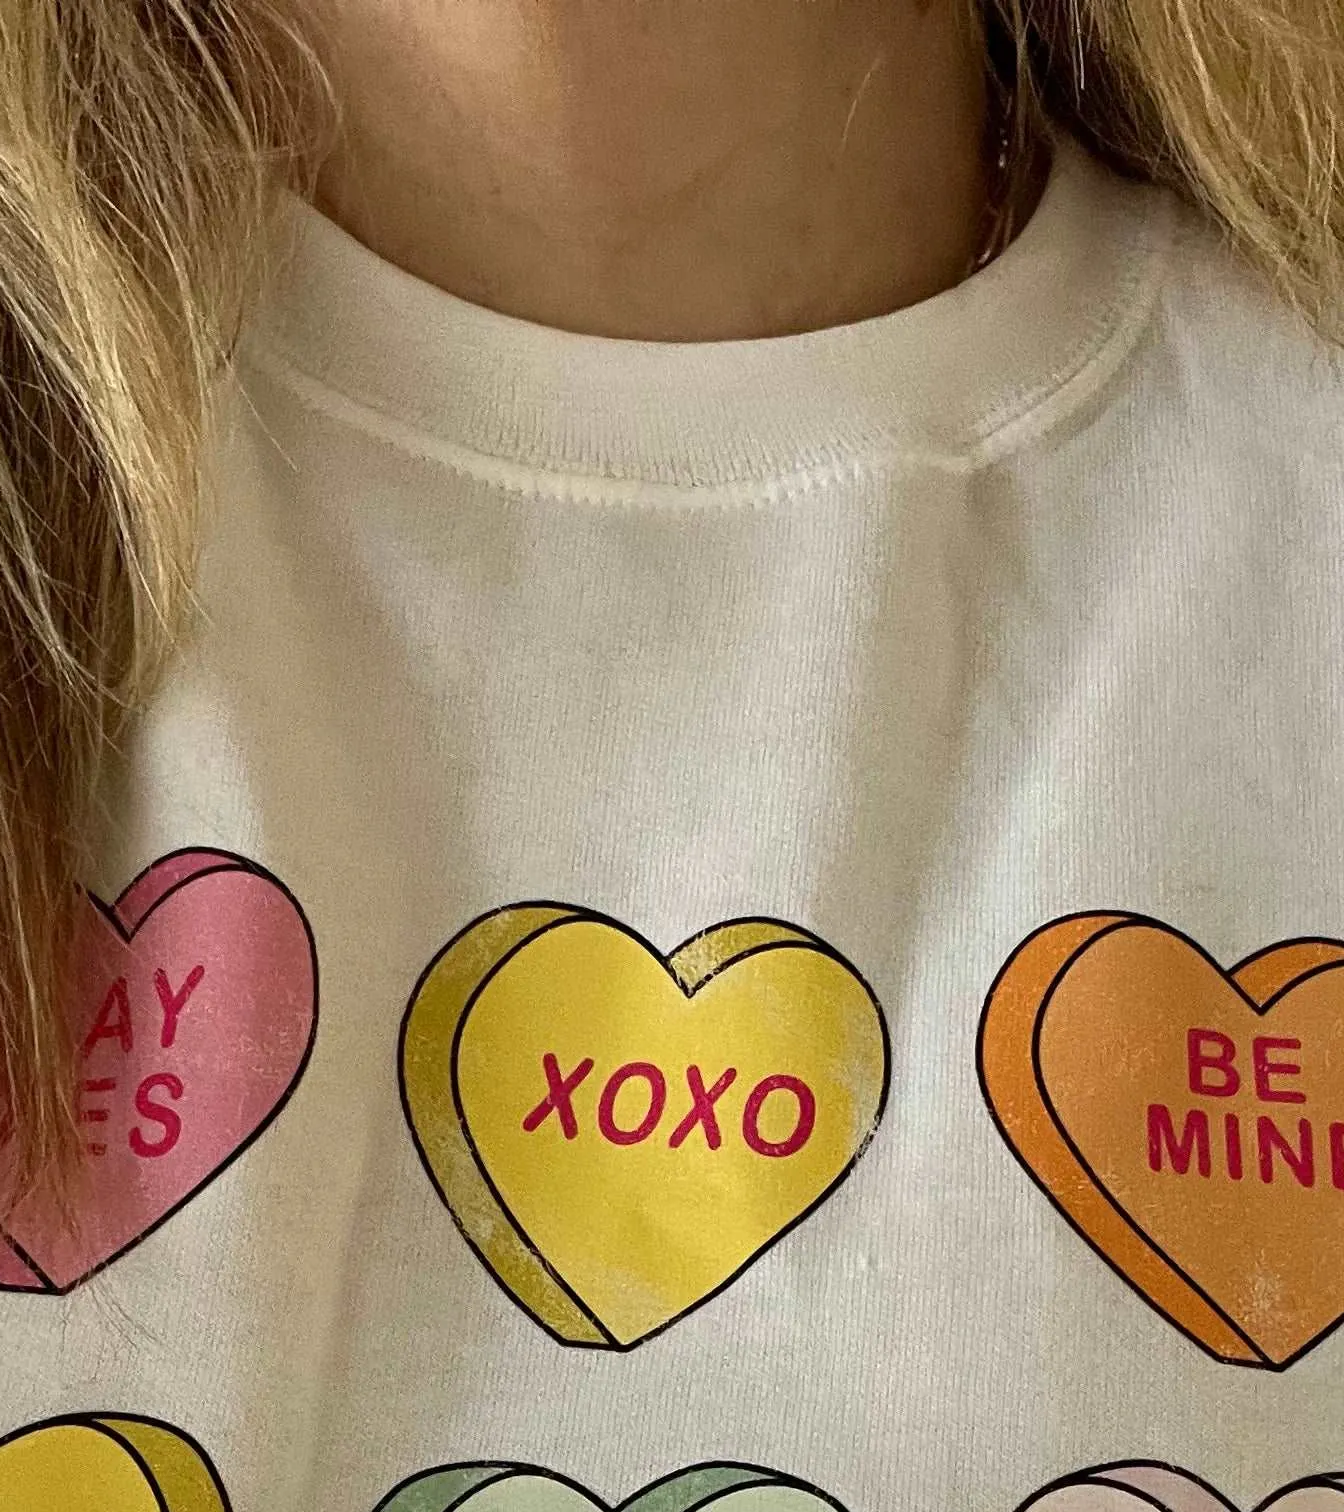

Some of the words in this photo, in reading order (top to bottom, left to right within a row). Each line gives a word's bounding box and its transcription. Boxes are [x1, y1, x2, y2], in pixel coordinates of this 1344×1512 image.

[82, 964, 205, 1059] AY
[524, 1055, 815, 1157] XOXO
[1188, 1029, 1305, 1104] BE
[76, 1072, 185, 1159] ES
